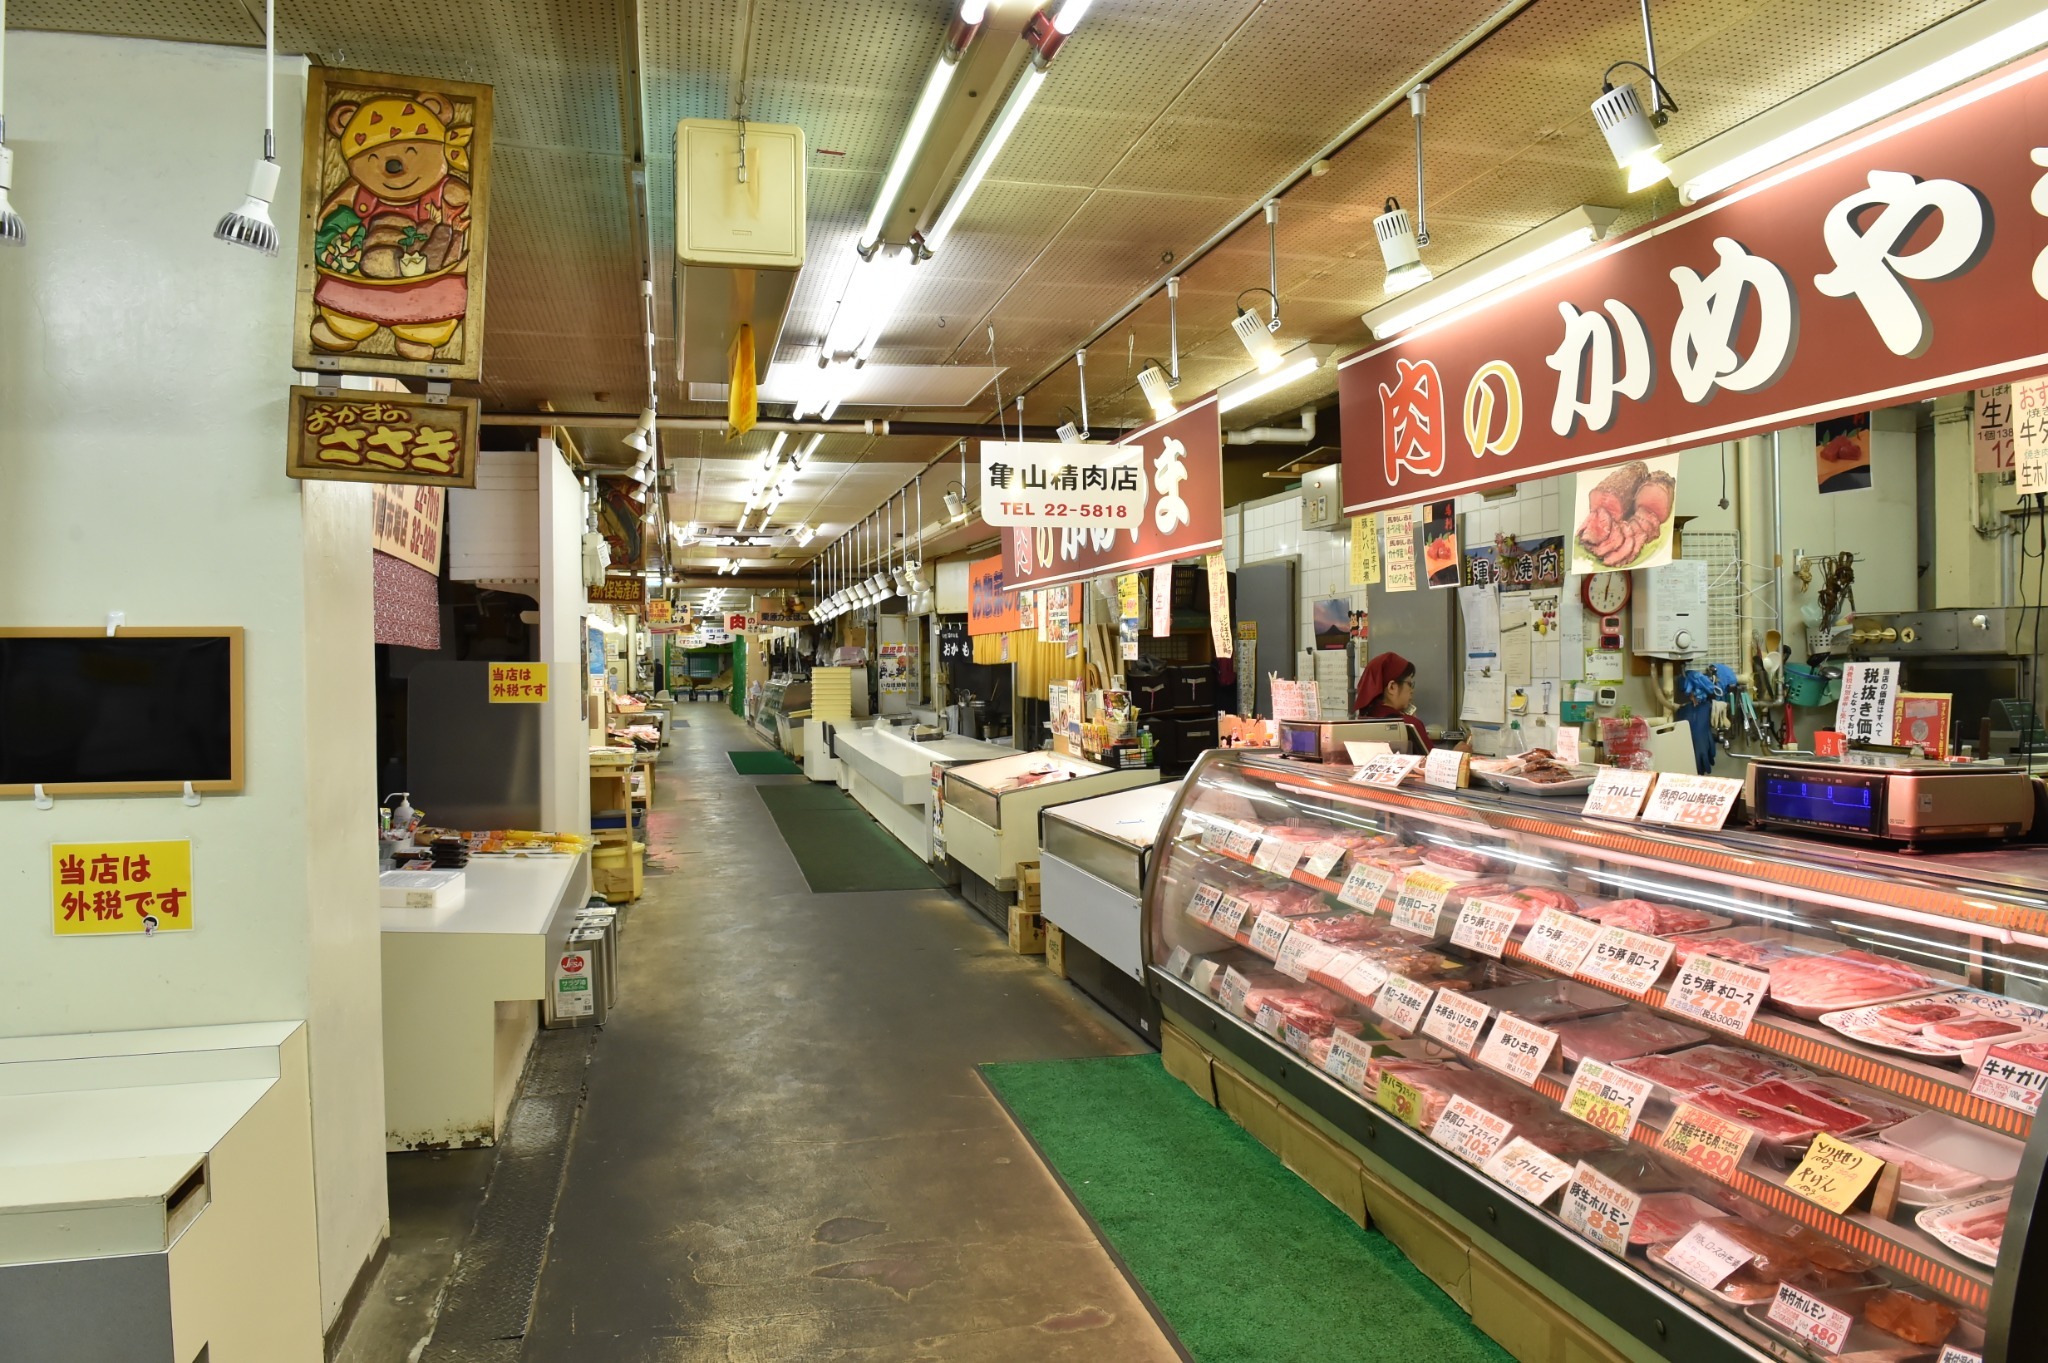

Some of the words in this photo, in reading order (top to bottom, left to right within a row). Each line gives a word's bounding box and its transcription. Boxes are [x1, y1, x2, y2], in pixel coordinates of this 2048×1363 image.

[1379, 148, 2048, 487] 肉のかめや
[306, 402, 410, 434] おかずの
[318, 425, 459, 475] ささき
[988, 461, 1139, 492] 亀山精肉店
[1000, 501, 1036, 516] TEL
[1044, 503, 1128, 518] 22-5818
[1472, 551, 1558, 587] 運焼肉
[492, 668, 532, 682] 当店は
[492, 683, 547, 697] 外税です
[58, 852, 152, 886] 当店は
[60, 886, 188, 922] 外税です
[1682, 973, 1718, 994] もち豚
[1716, 984, 1755, 1006] 本ロース
[1500, 1033, 1539, 1058] 豚ひき肉
[1569, 1181, 1630, 1227] 豚生ホルモン
[1779, 1286, 1827, 1320] 味付ホルモン
